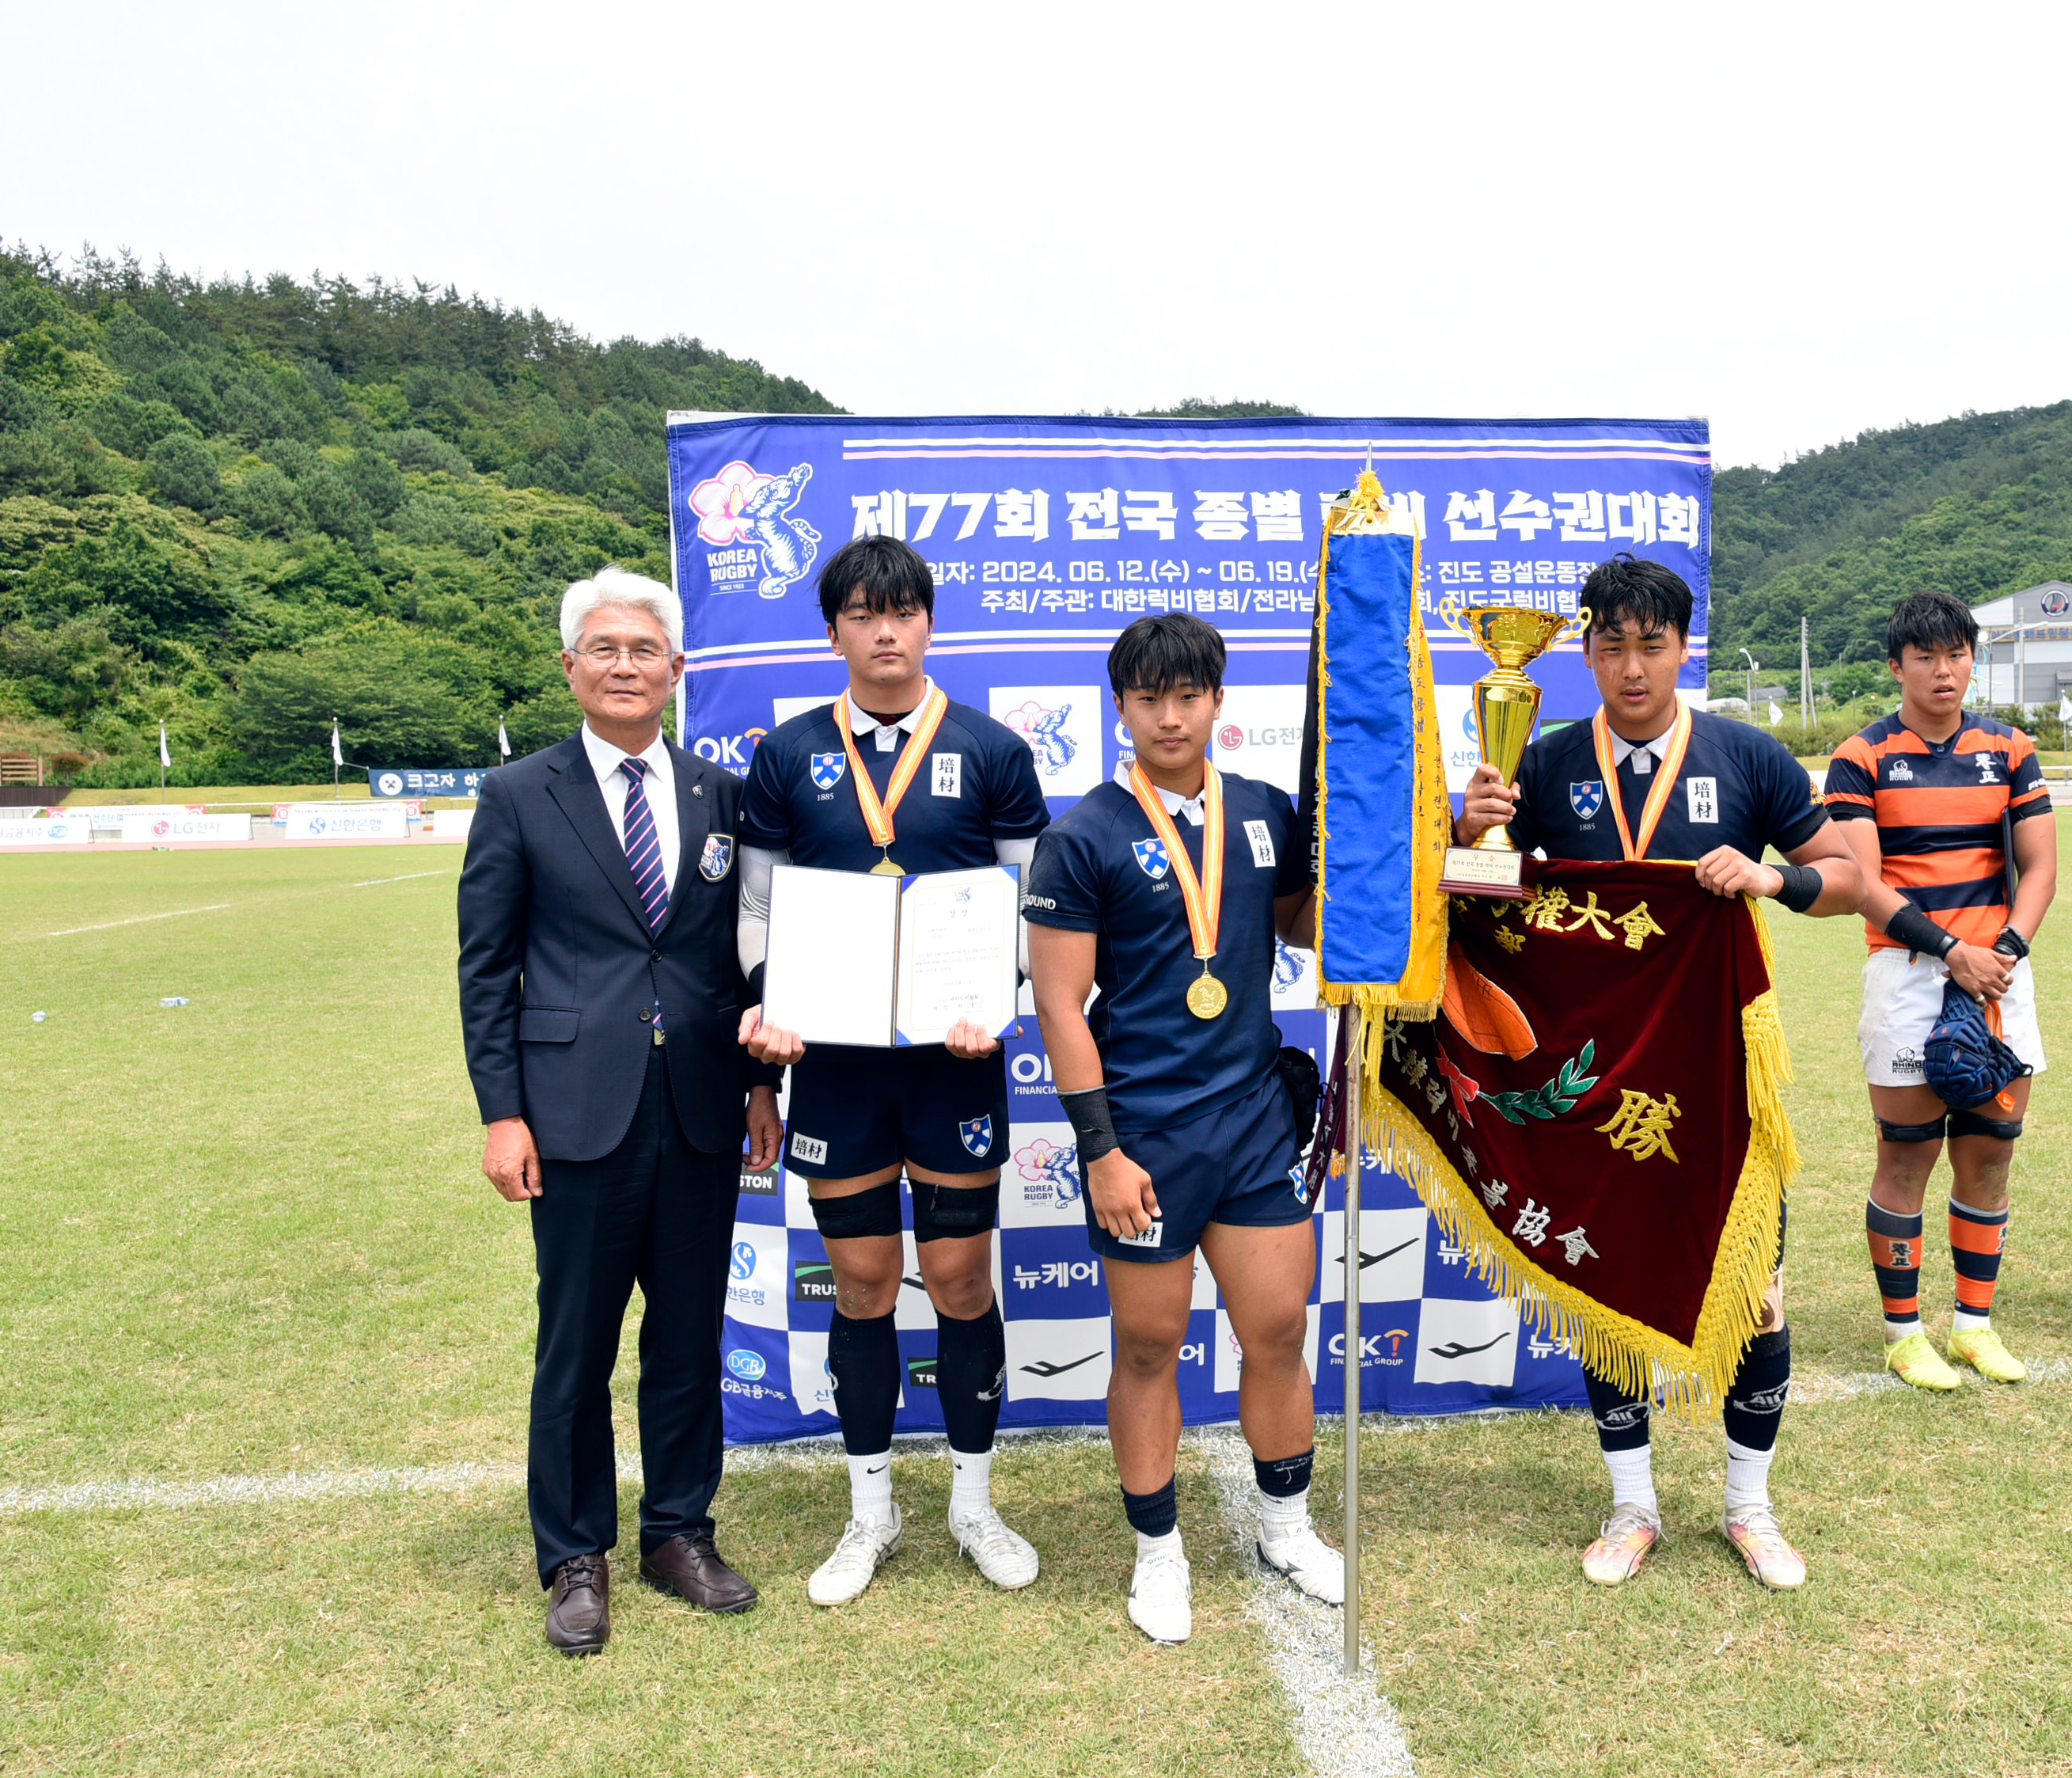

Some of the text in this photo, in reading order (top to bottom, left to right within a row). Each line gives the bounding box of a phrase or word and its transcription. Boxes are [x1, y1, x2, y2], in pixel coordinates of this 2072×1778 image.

[851, 487, 1049, 543] 제77회
[1066, 487, 1178, 541] 전국
[1193, 489, 1304, 541] 종별
[1444, 489, 1701, 549] 선수권대회
[707, 549, 757, 568] KOREA
[710, 564, 757, 583] RUGBY
[927, 561, 975, 586] 일자:
[982, 561, 1062, 583] 2024.
[1069, 561, 1111, 583] 06.
[1117, 560, 1190, 583] 12.(수)
[1220, 560, 1262, 582] 06.
[1438, 561, 1485, 584] 진도
[1489, 560, 1597, 584] 공설운동장
[981, 587, 1317, 614] 주최/주관: 대한럭비협회/전라남
[1450, 750, 1482, 767] 신한
[408, 772, 456, 788] 크고자
[817, 793, 835, 802] 1885
[330, 818, 382, 831] 신한은행
[1579, 823, 1596, 832] 1885
[1152, 881, 1170, 893] 1885
[1024, 894, 1057, 910] ROUND
[1015, 1085, 1058, 1095] FINANCIA
[1594, 1088, 1681, 1164] 勝
[739, 1176, 772, 1189] STON
[1129, 1225, 1157, 1243] 材
[1012, 1260, 1099, 1290] 뉴케어
[726, 1287, 765, 1306] 한은행
[801, 1282, 838, 1296] TRUS
[731, 1354, 760, 1373] DGB
[1375, 1358, 1403, 1366] GROUP
[720, 1377, 787, 1401] GB금융지주
